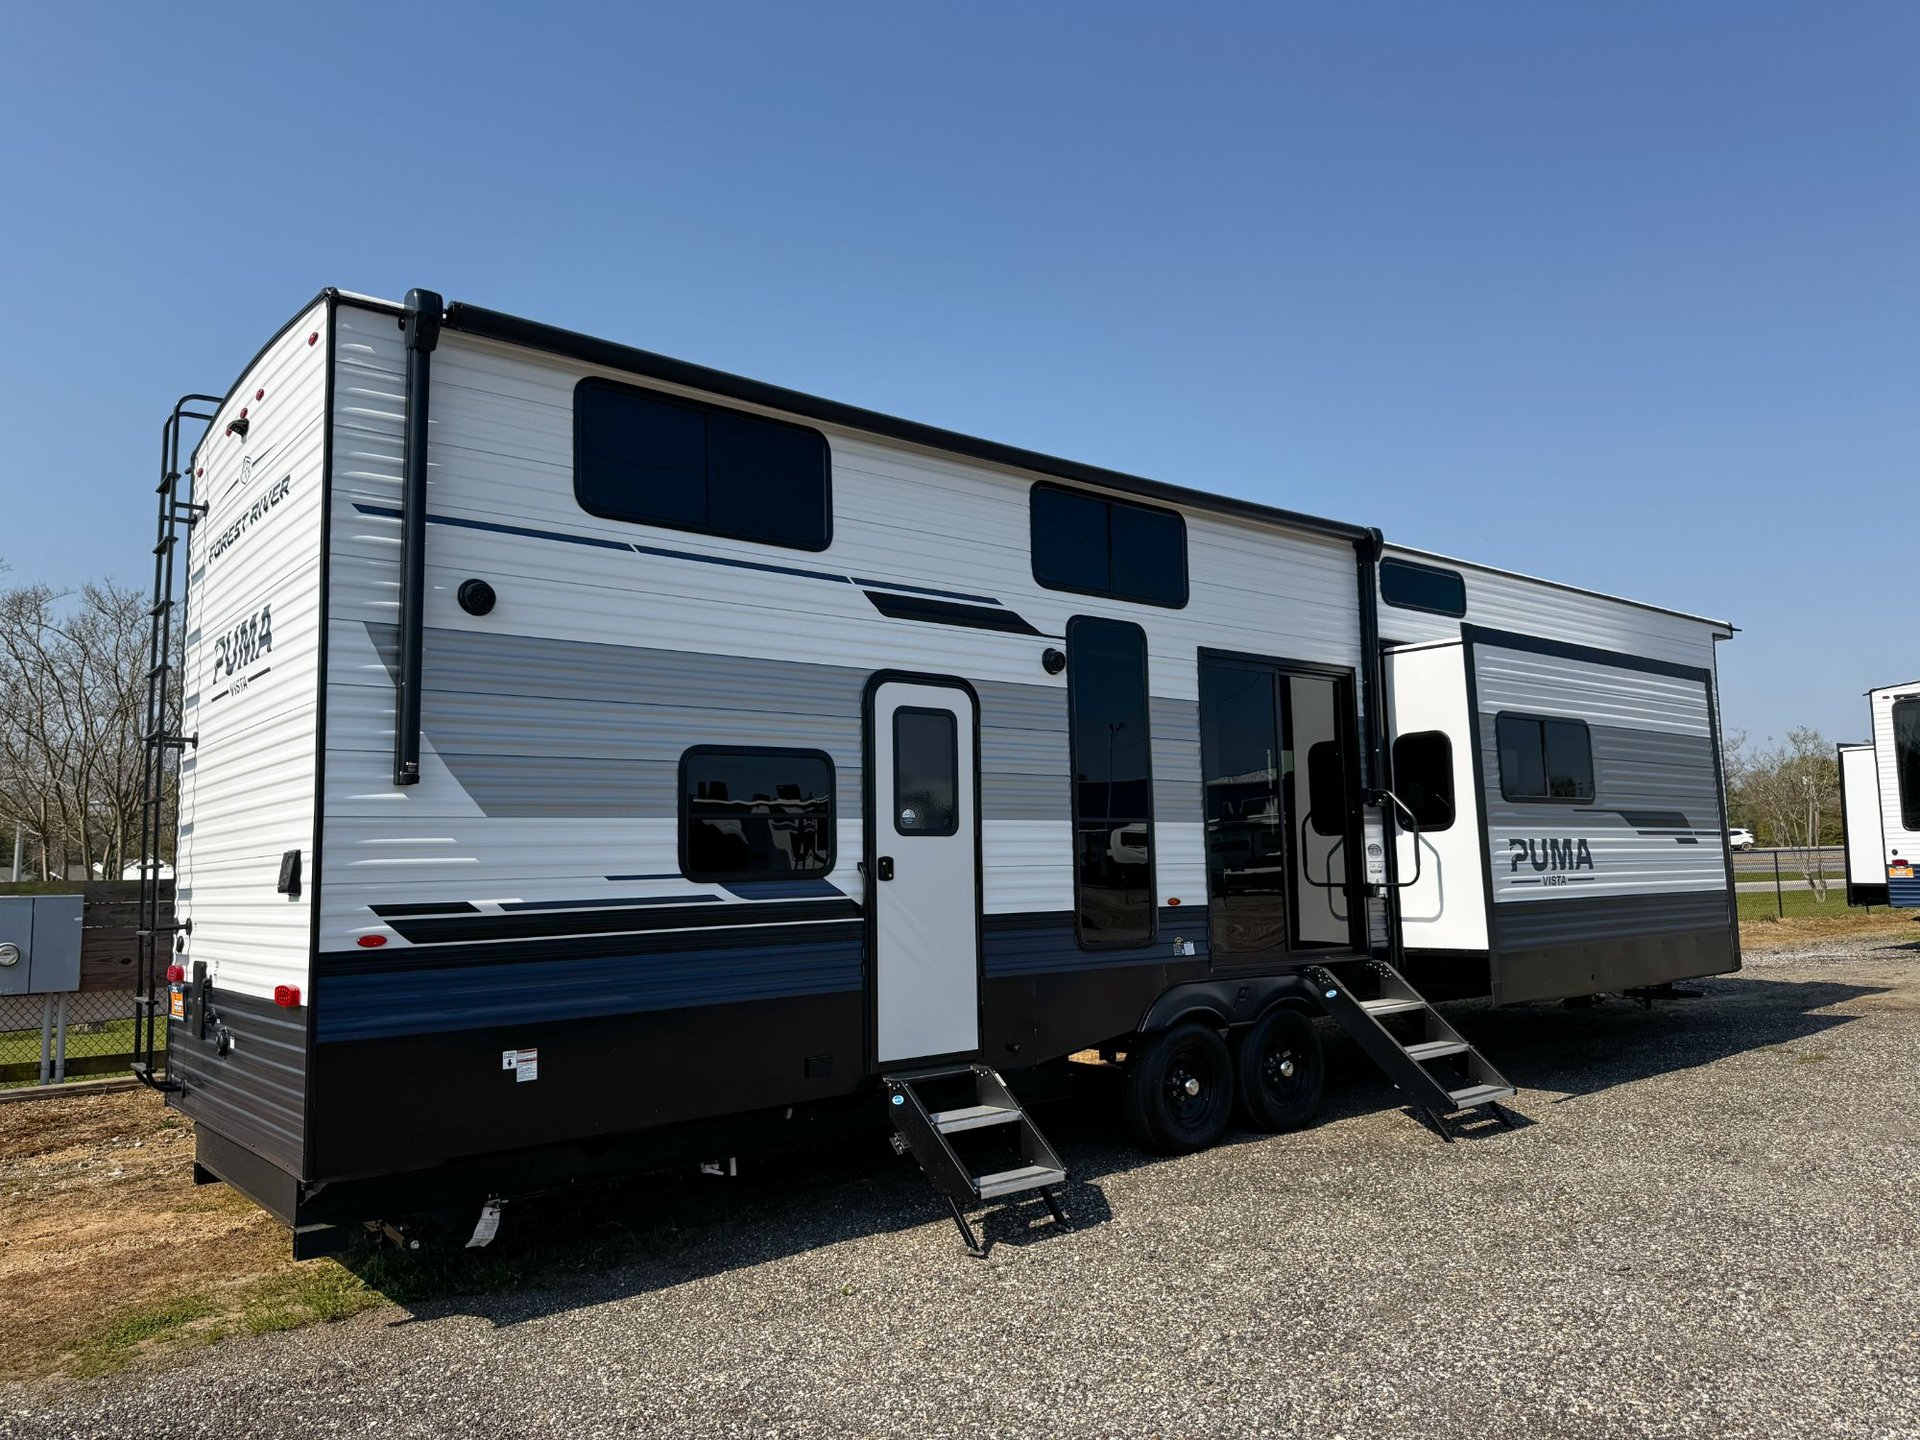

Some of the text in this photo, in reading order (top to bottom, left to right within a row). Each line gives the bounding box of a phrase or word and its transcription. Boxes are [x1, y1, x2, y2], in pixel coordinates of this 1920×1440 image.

[208, 474, 291, 564] FOREST RIVER
[213, 603, 272, 685] PUMA
[229, 676, 249, 697] VISTA
[1508, 838, 1594, 872] PUMA
[1542, 875, 1567, 886] VISTA
